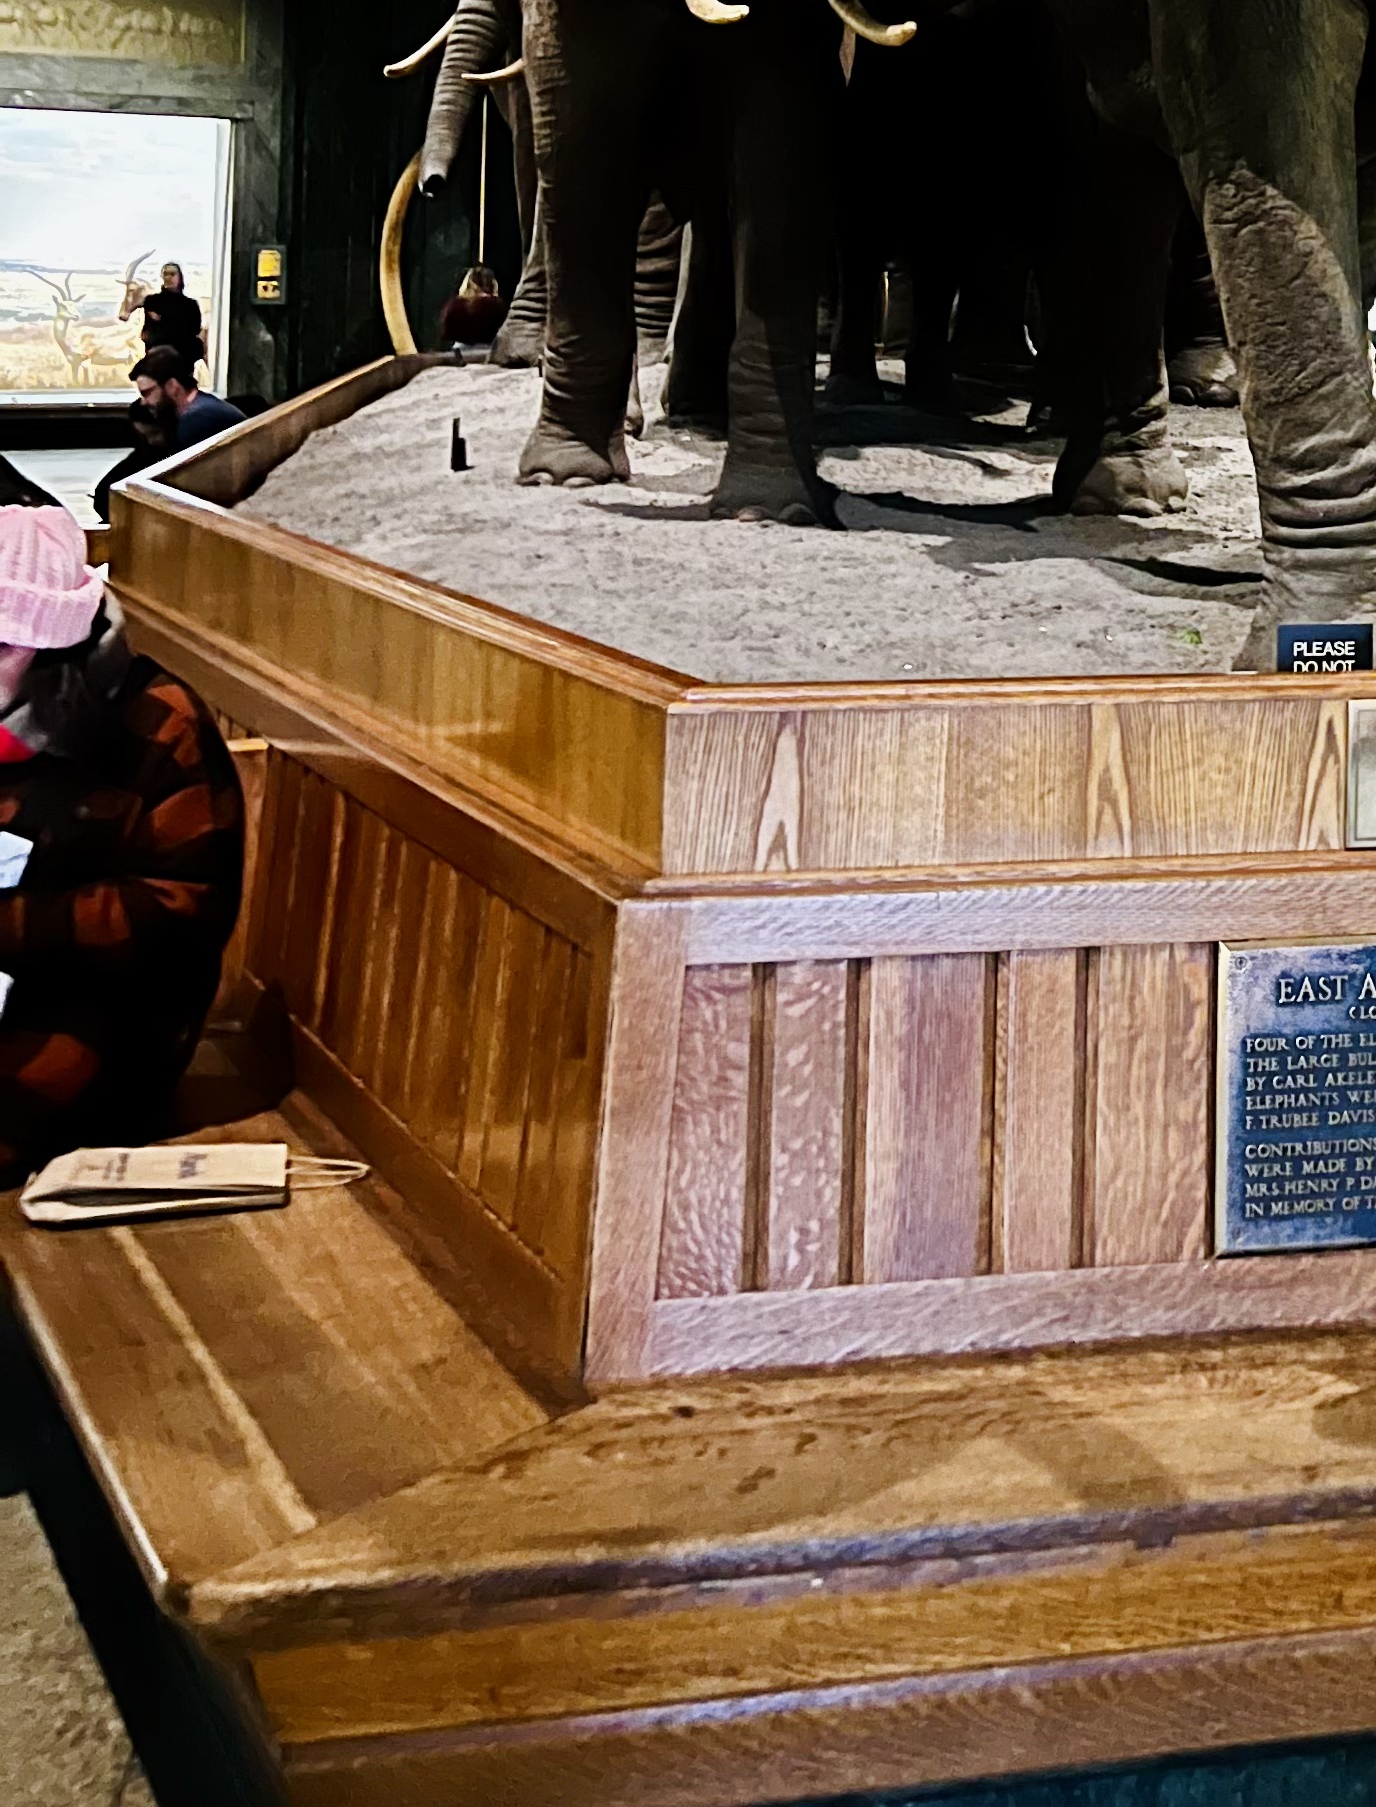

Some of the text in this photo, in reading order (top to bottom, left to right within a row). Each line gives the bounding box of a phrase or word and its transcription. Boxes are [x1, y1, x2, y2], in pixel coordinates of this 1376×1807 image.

[1293, 640, 1356, 657] PLEASE
[1293, 659, 1356, 673] DO NOT
[1278, 974, 1349, 1004] EAST
[1246, 1037, 1289, 1053] FOUR
[1295, 1035, 1317, 1050] OF
[1320, 1033, 1353, 1049] THE
[1246, 1057, 1280, 1073] THE
[1287, 1054, 1341, 1070] LARGE
[1246, 1076, 1267, 1091] BY
[1272, 1073, 1318, 1089] CARL
[1246, 1091, 1340, 1110] ELEPHANTS
[1259, 1111, 1320, 1130] TRUBEE
[1244, 1161, 1294, 1178] WERE
[1302, 1158, 1348, 1175] MADE
[1355, 1155, 1375, 1172] BY
[1284, 1178, 1340, 1195] HENRY
[1245, 1202, 1264, 1218] IN
[1270, 1197, 1336, 1216] MEMORY
[1341, 1195, 1361, 1211] OF
